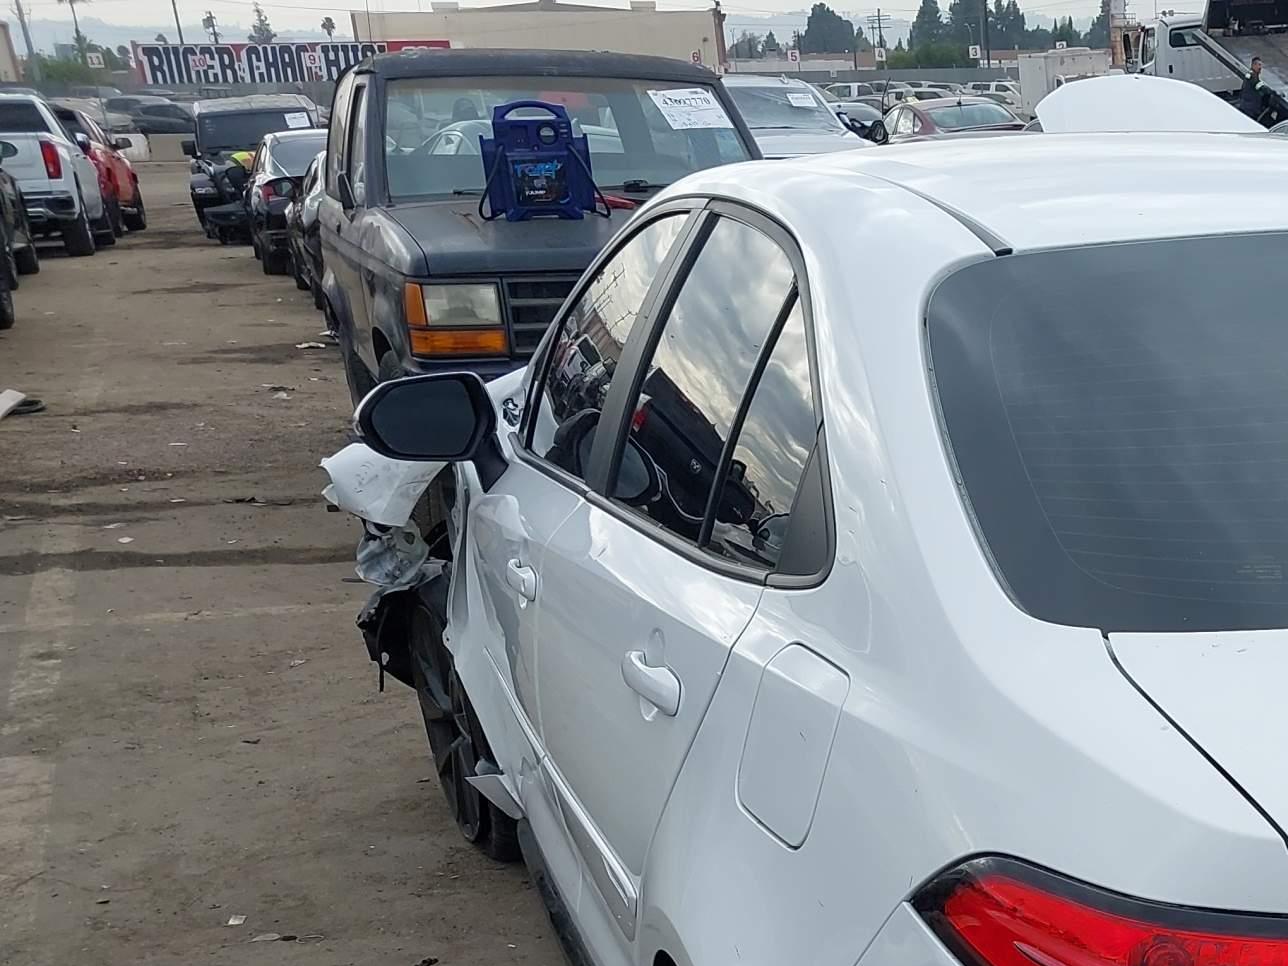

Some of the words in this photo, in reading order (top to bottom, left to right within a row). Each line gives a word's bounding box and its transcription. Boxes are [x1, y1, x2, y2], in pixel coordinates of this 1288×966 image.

[691, 52, 699, 62] 6
[789, 51, 798, 62] 5
[970, 47, 978, 57] 3
[191, 56, 207, 68] 10
[308, 54, 316, 64] 9
